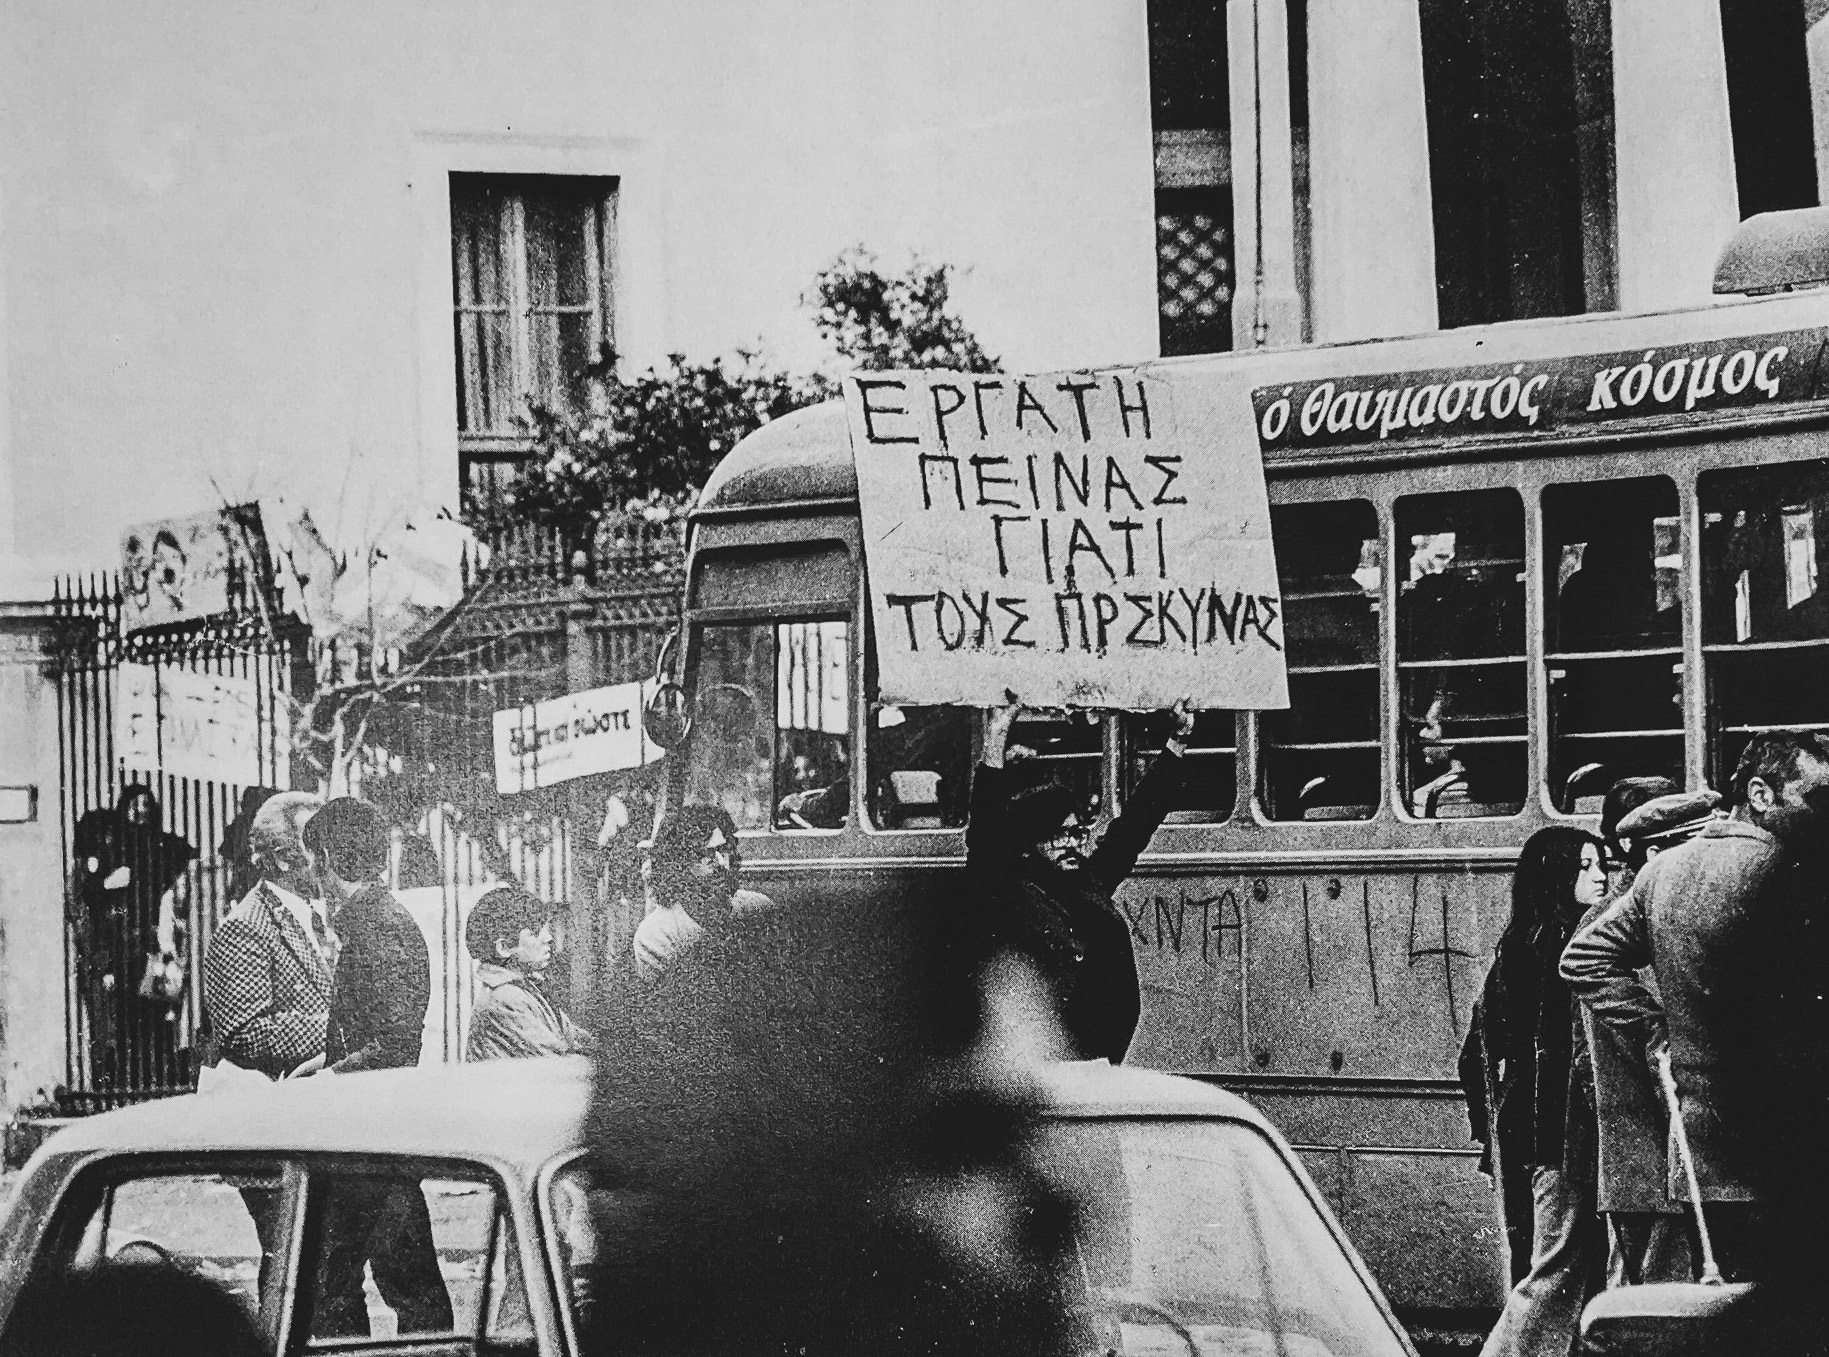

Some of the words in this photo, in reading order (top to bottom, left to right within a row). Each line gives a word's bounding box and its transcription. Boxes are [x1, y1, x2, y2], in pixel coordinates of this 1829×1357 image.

[851, 376, 1152, 450] ΕΡΓΑΤΗ
[1300, 363, 1549, 439] θαυμαστός
[1586, 345, 1789, 413] κόσμος
[918, 452, 1188, 512] ΠΕΙΝΑΣ
[991, 515, 1167, 586] ΓΙΑΤΙ
[885, 587, 1036, 652] ΤΟΥΣ
